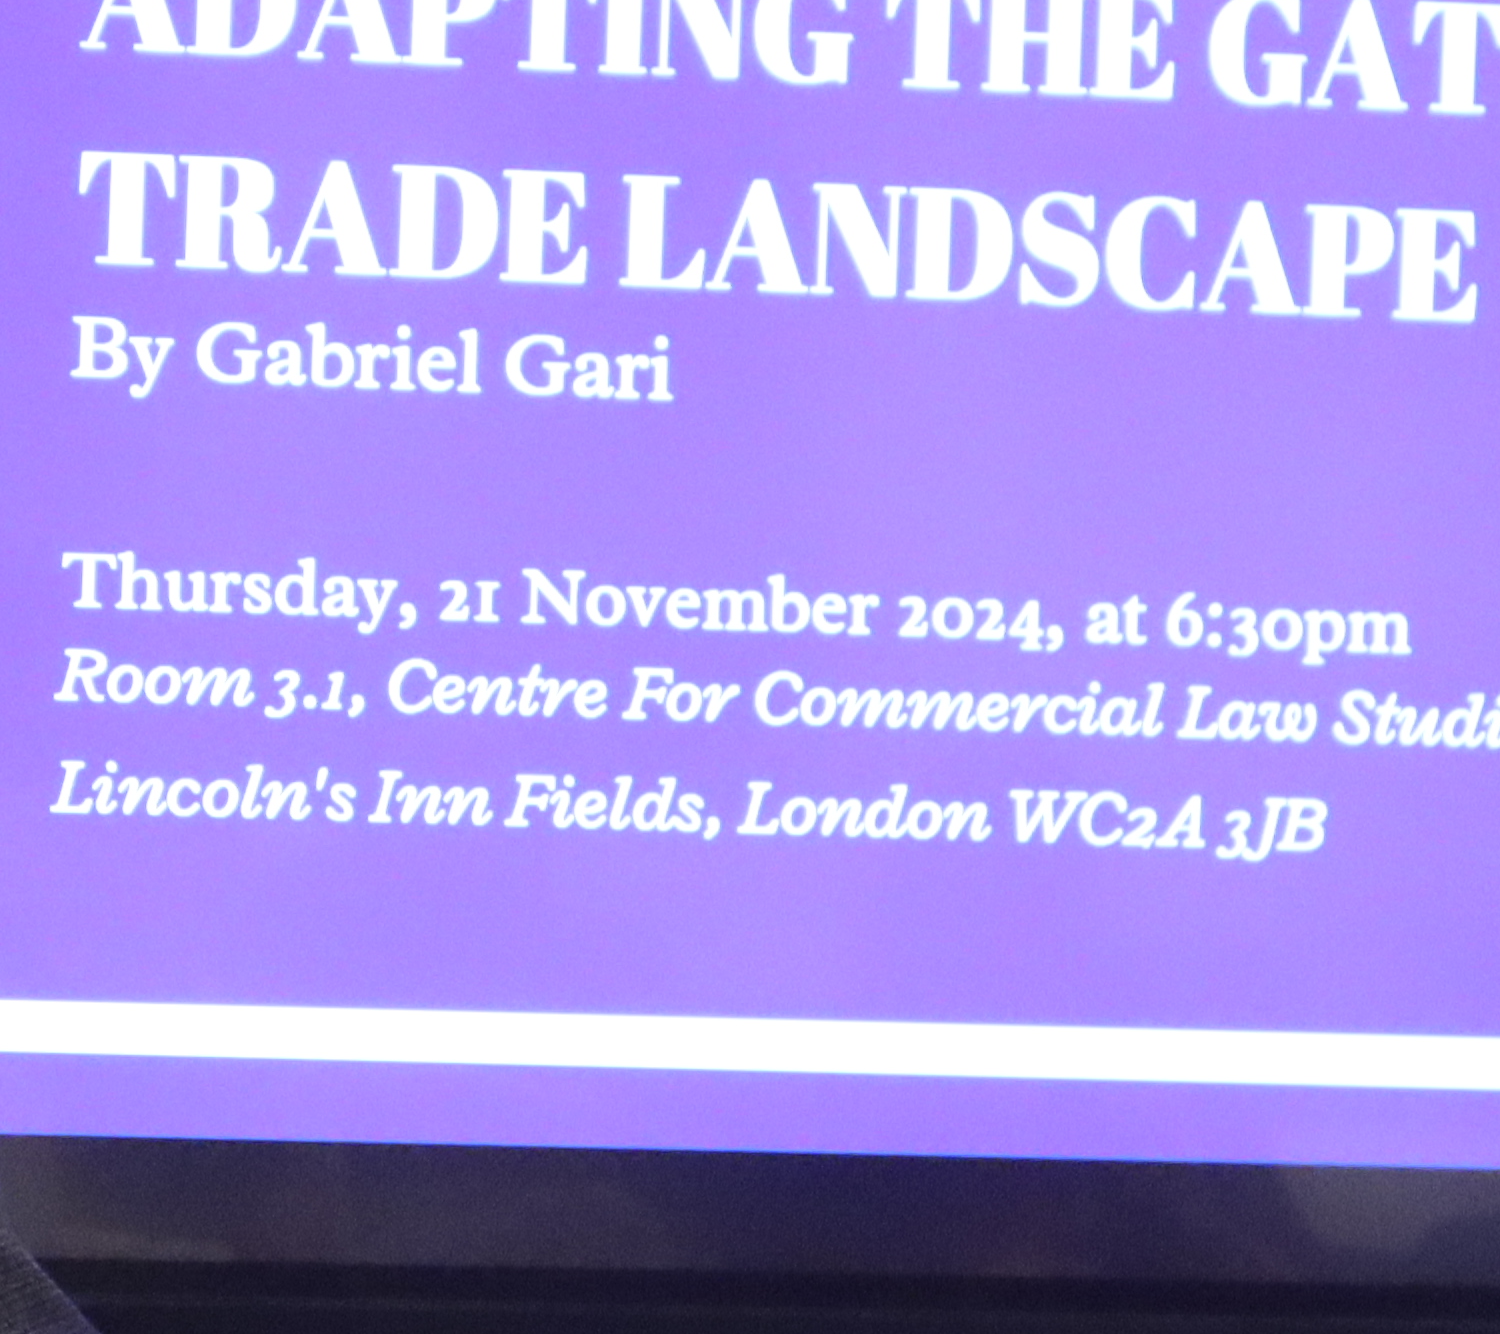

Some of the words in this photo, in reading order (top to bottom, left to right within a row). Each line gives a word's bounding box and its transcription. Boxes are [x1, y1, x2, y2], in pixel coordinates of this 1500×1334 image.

[79, 151, 588, 285] TRADE
[619, 174, 1477, 324] LANDSCAPE
[70, 314, 176, 401] By
[196, 322, 482, 394] Gabriel
[505, 334, 674, 402] Gari
[62, 551, 417, 635] Thursday,
[439, 580, 501, 623] 21
[521, 568, 880, 636] November
[898, 595, 1064, 653] 2024,
[1085, 595, 1148, 646] at
[1165, 592, 1412, 666] 6:30pm
[54, 648, 255, 707] Room
[264, 669, 365, 719] 3.1,
[388, 658, 608, 719] Centre
[622, 667, 741, 722] For
[754, 670, 1165, 738] Commercial
[1176, 685, 1318, 743] Law
[50, 760, 357, 822] Lincoln's
[368, 770, 493, 826] Inn
[504, 774, 721, 840] Fields,
[736, 781, 992, 842] London
[1009, 789, 1206, 849] WC2A
[1215, 796, 1328, 862] 3JB
